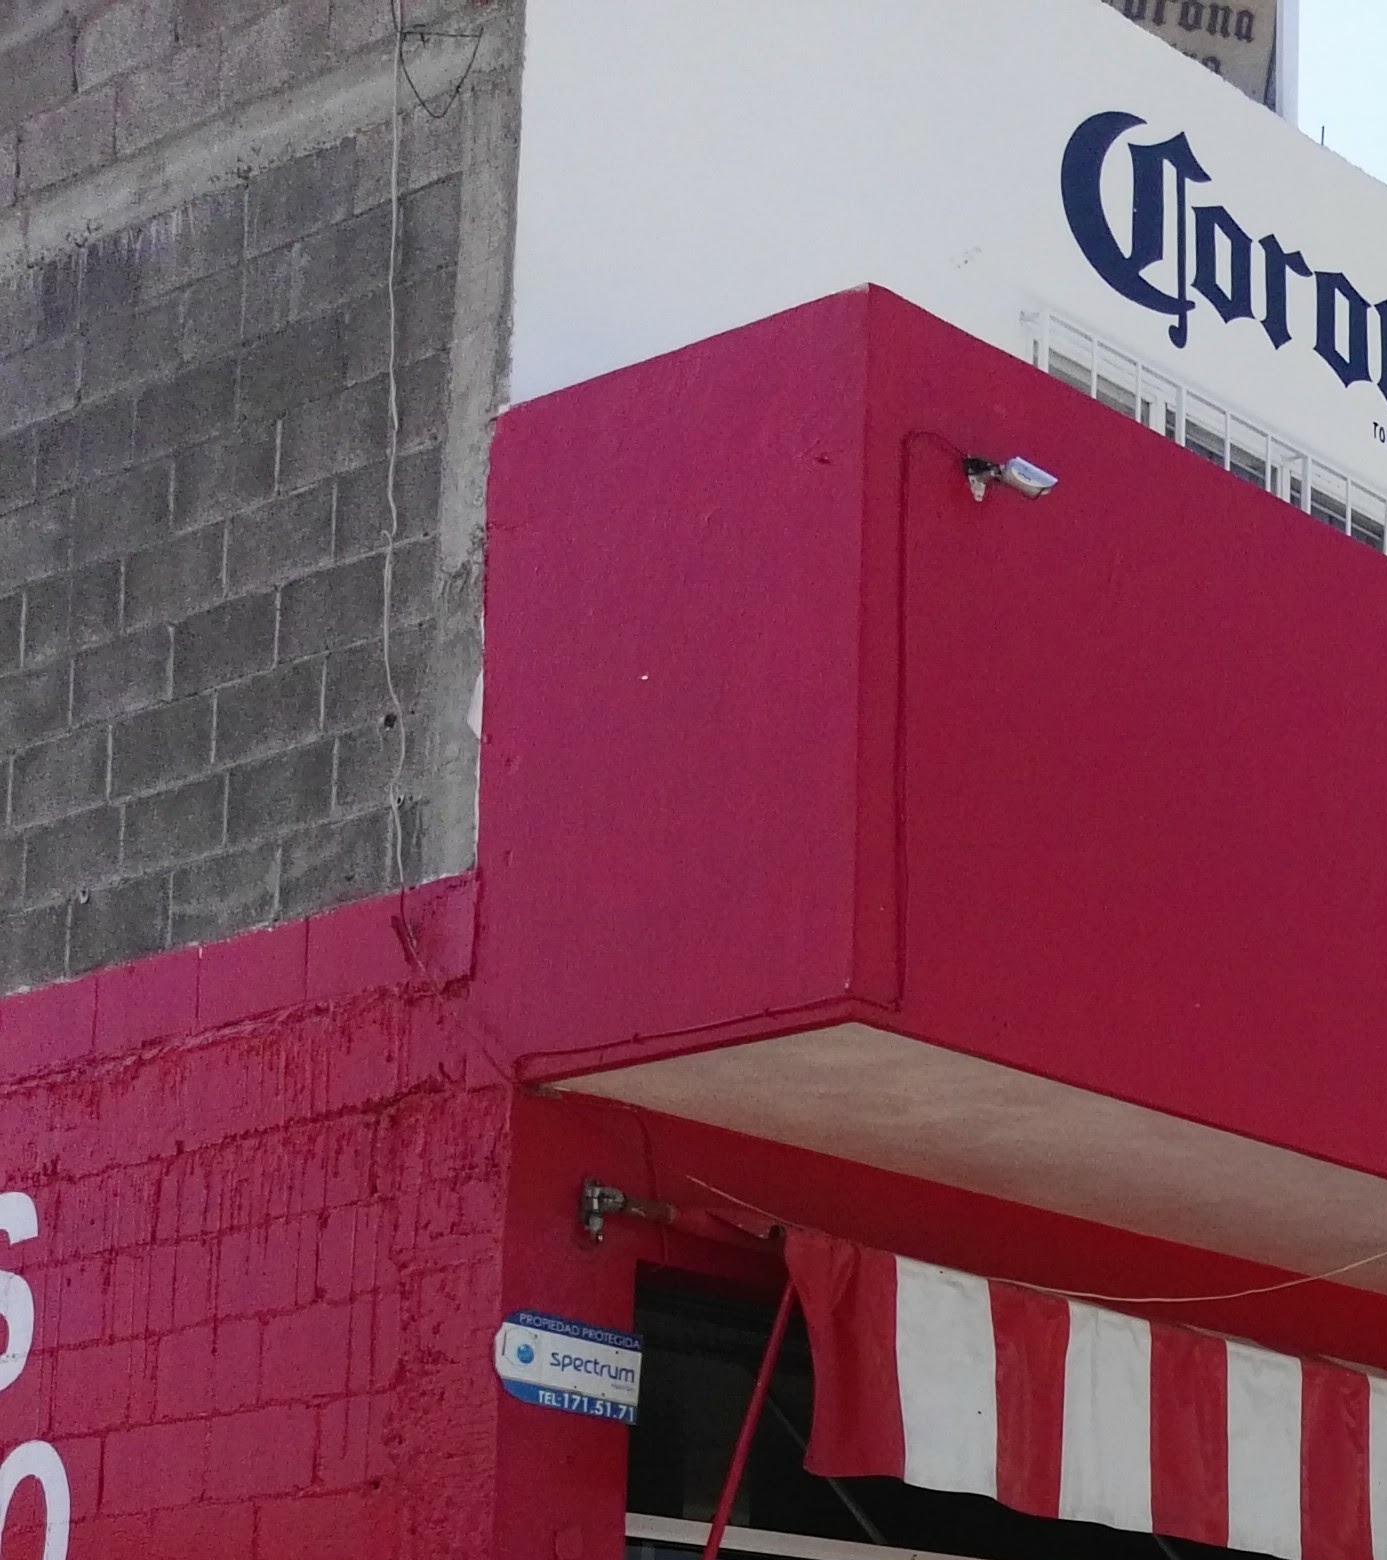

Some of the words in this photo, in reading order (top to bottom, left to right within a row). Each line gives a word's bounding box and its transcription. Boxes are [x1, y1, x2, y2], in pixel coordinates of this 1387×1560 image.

[1105, 0, 1255, 43] orona
[519, 1312, 580, 1336] PROPIEDAD
[581, 1327, 641, 1350] PROTEGIDA
[549, 1351, 635, 1384] spectrum
